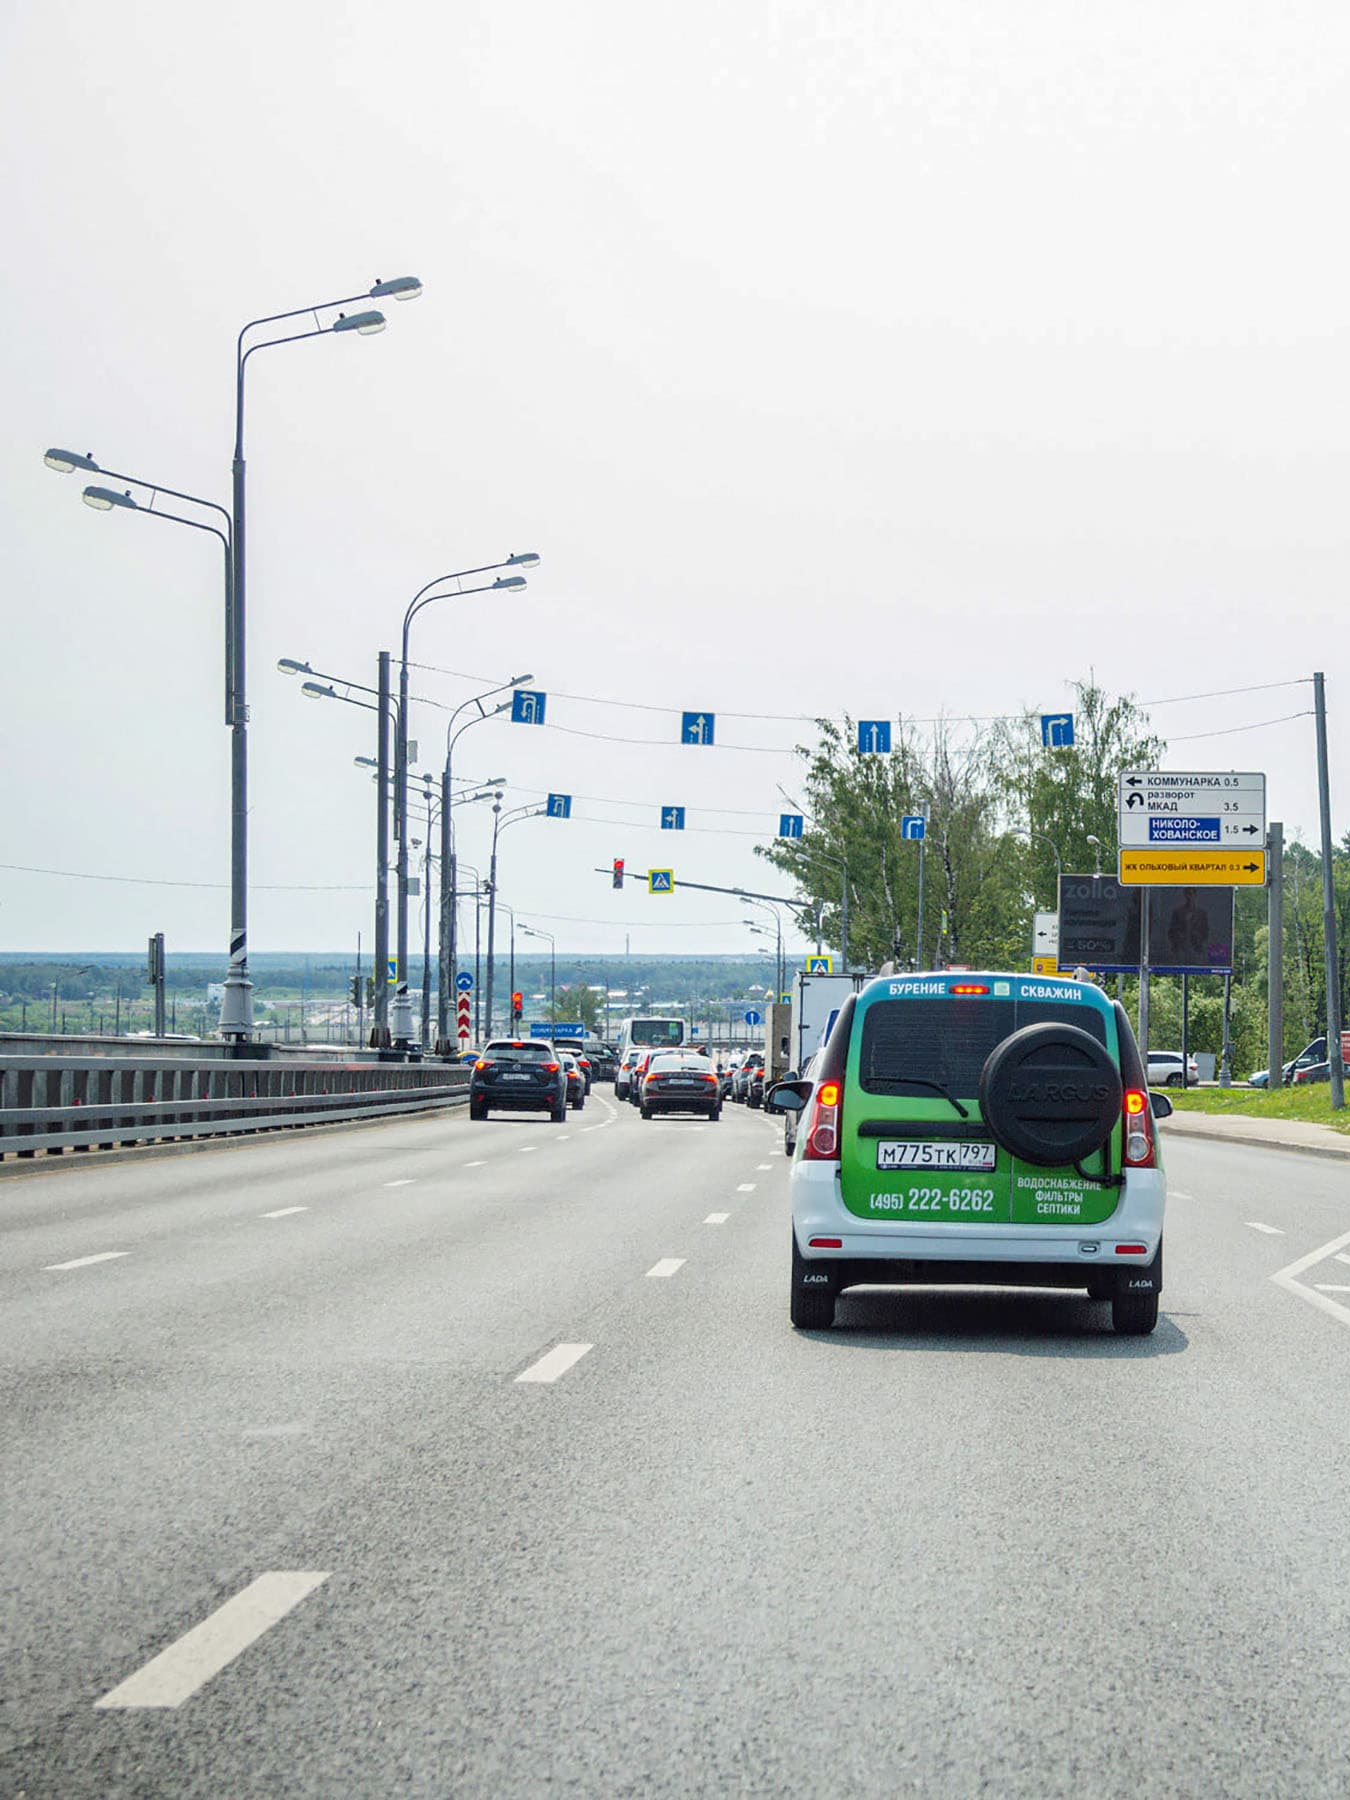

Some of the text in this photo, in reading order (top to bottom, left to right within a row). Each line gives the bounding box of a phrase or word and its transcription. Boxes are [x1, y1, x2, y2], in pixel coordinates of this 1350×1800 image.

[1147, 778, 1240, 787] КОММУНАРКА 0.5
[1147, 791, 1195, 800] разворот
[1147, 802, 1239, 812] МКАД 3.5
[1152, 819, 1201, 829] НИКОЛО-
[1152, 825, 1239, 840] ХОВАНСКОЕ 1.5
[1139, 862, 1188, 871] ОЛЬХОВЫЙ
[889, 982, 946, 995] БУРЕНИЕ
[1020, 985, 1082, 1001] СКВАЖИН
[883, 1145, 990, 1163] М775ТК 797
[1017, 1177, 1102, 1191] ВОДОСНАБЖЕНИЕ
[870, 1188, 994, 1211] (495) 222-6262
[1035, 1191, 1083, 1203] ФИЛЬТРЫ
[1037, 1203, 1081, 1215] СЕПТИКИ
[803, 1275, 829, 1284] LADA
[1128, 1280, 1154, 1288] LADA
